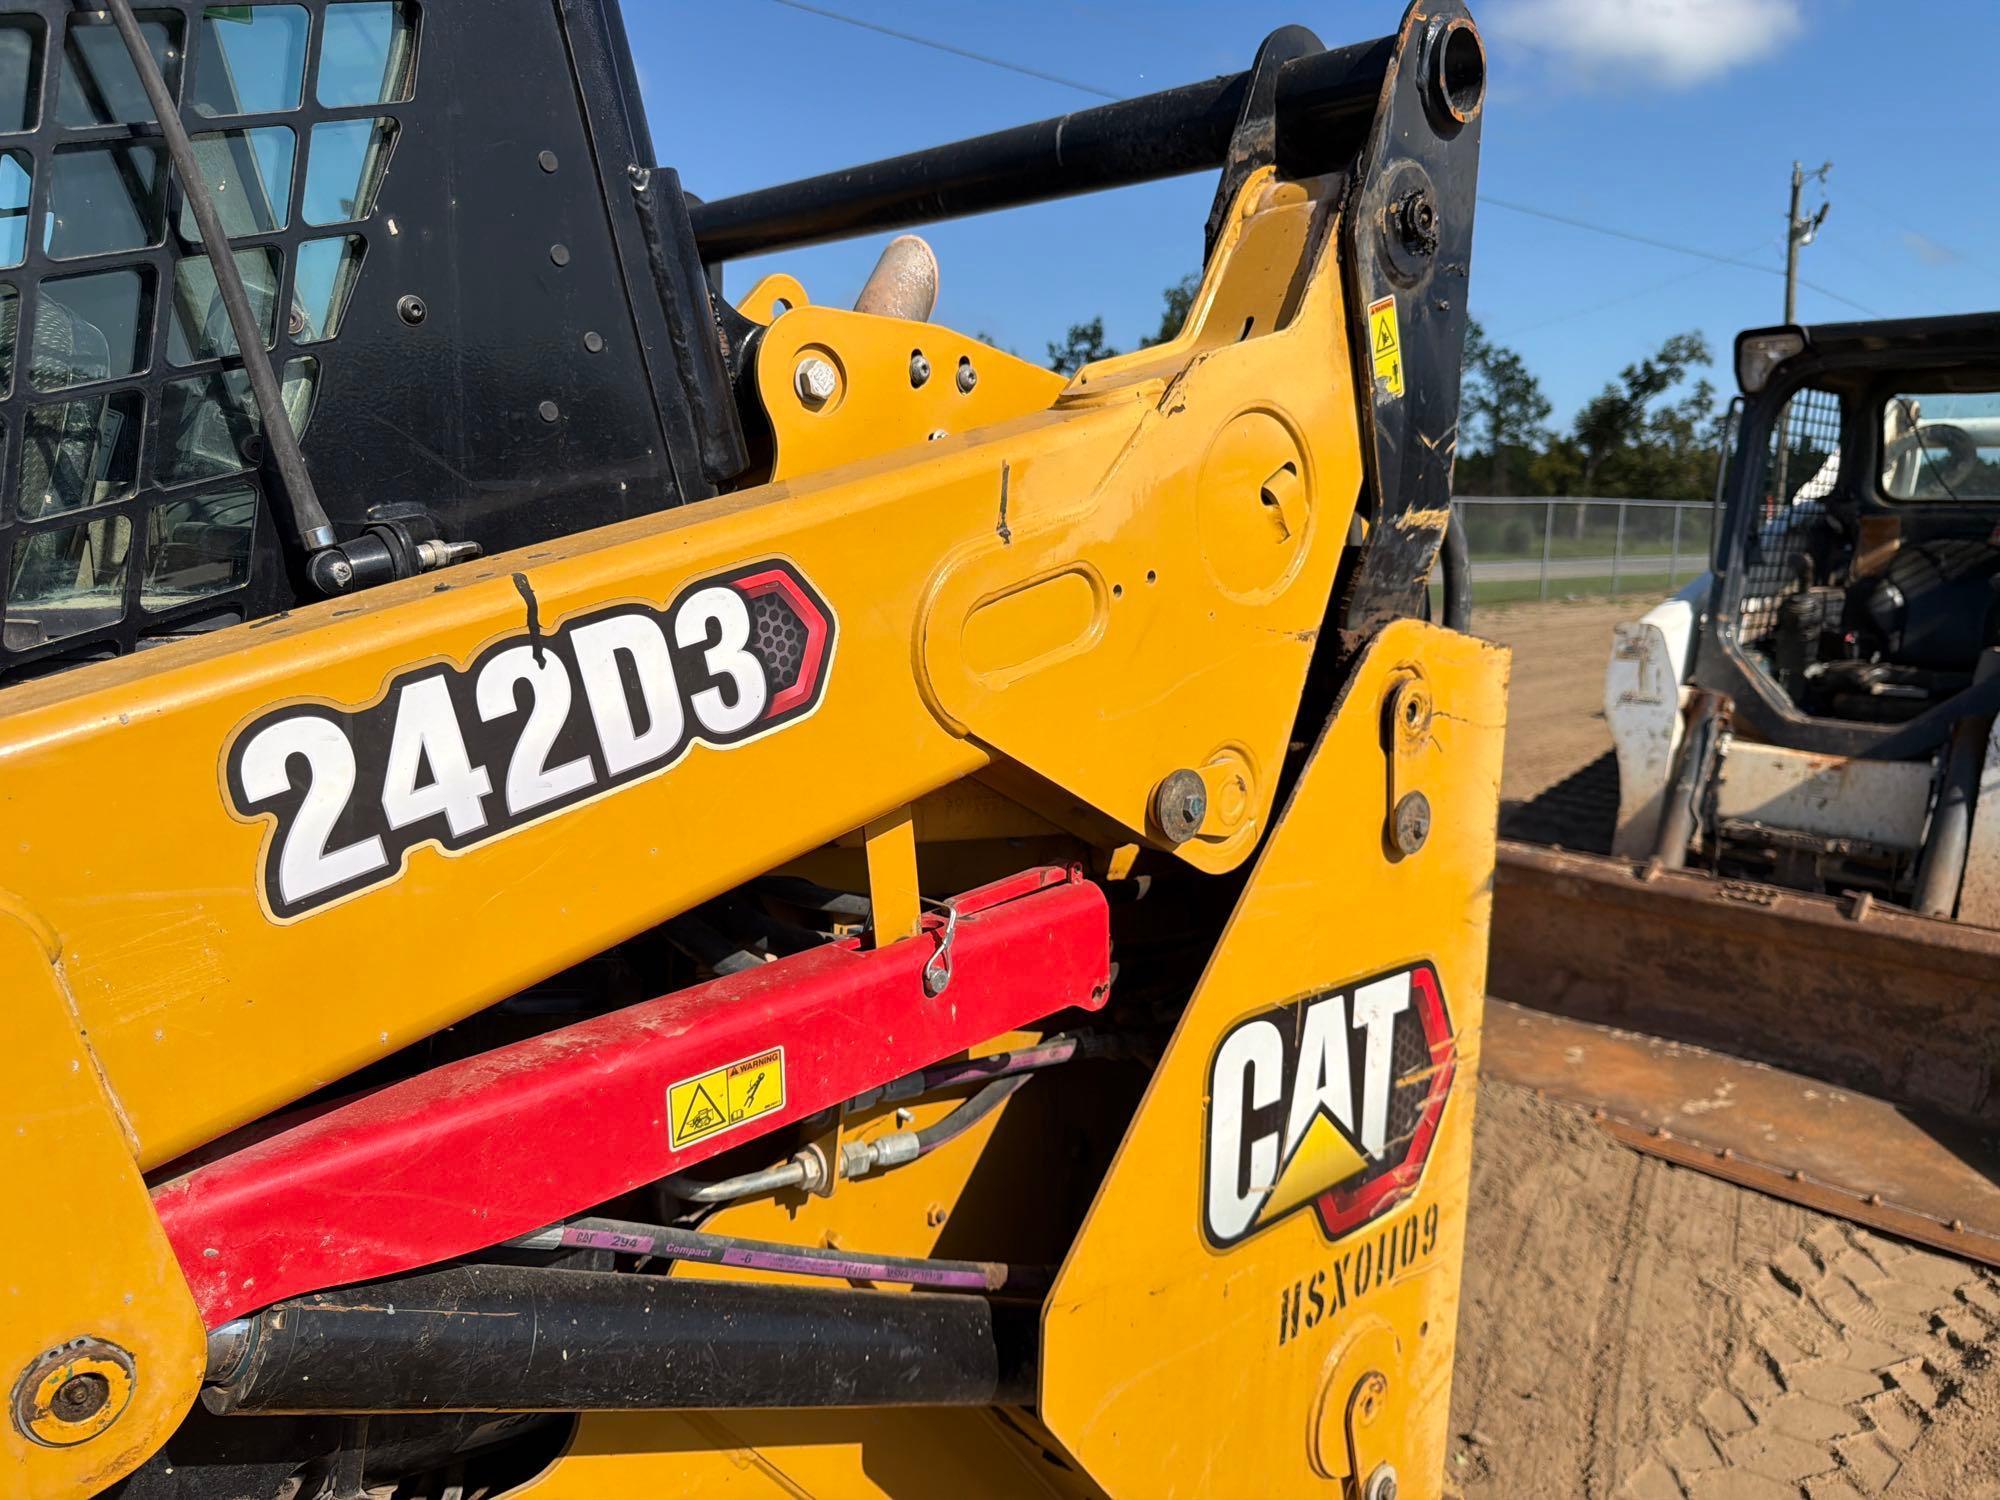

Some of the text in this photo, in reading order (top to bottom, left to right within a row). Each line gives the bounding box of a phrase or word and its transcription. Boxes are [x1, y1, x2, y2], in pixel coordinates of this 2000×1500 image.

[240, 586, 767, 905] 242D3
[739, 1053, 778, 1073] WARNING
[1209, 970, 1412, 1240] CAT
[575, 1231, 597, 1246] CAT
[609, 1234, 639, 1249] 294
[665, 1242, 714, 1258] Compact
